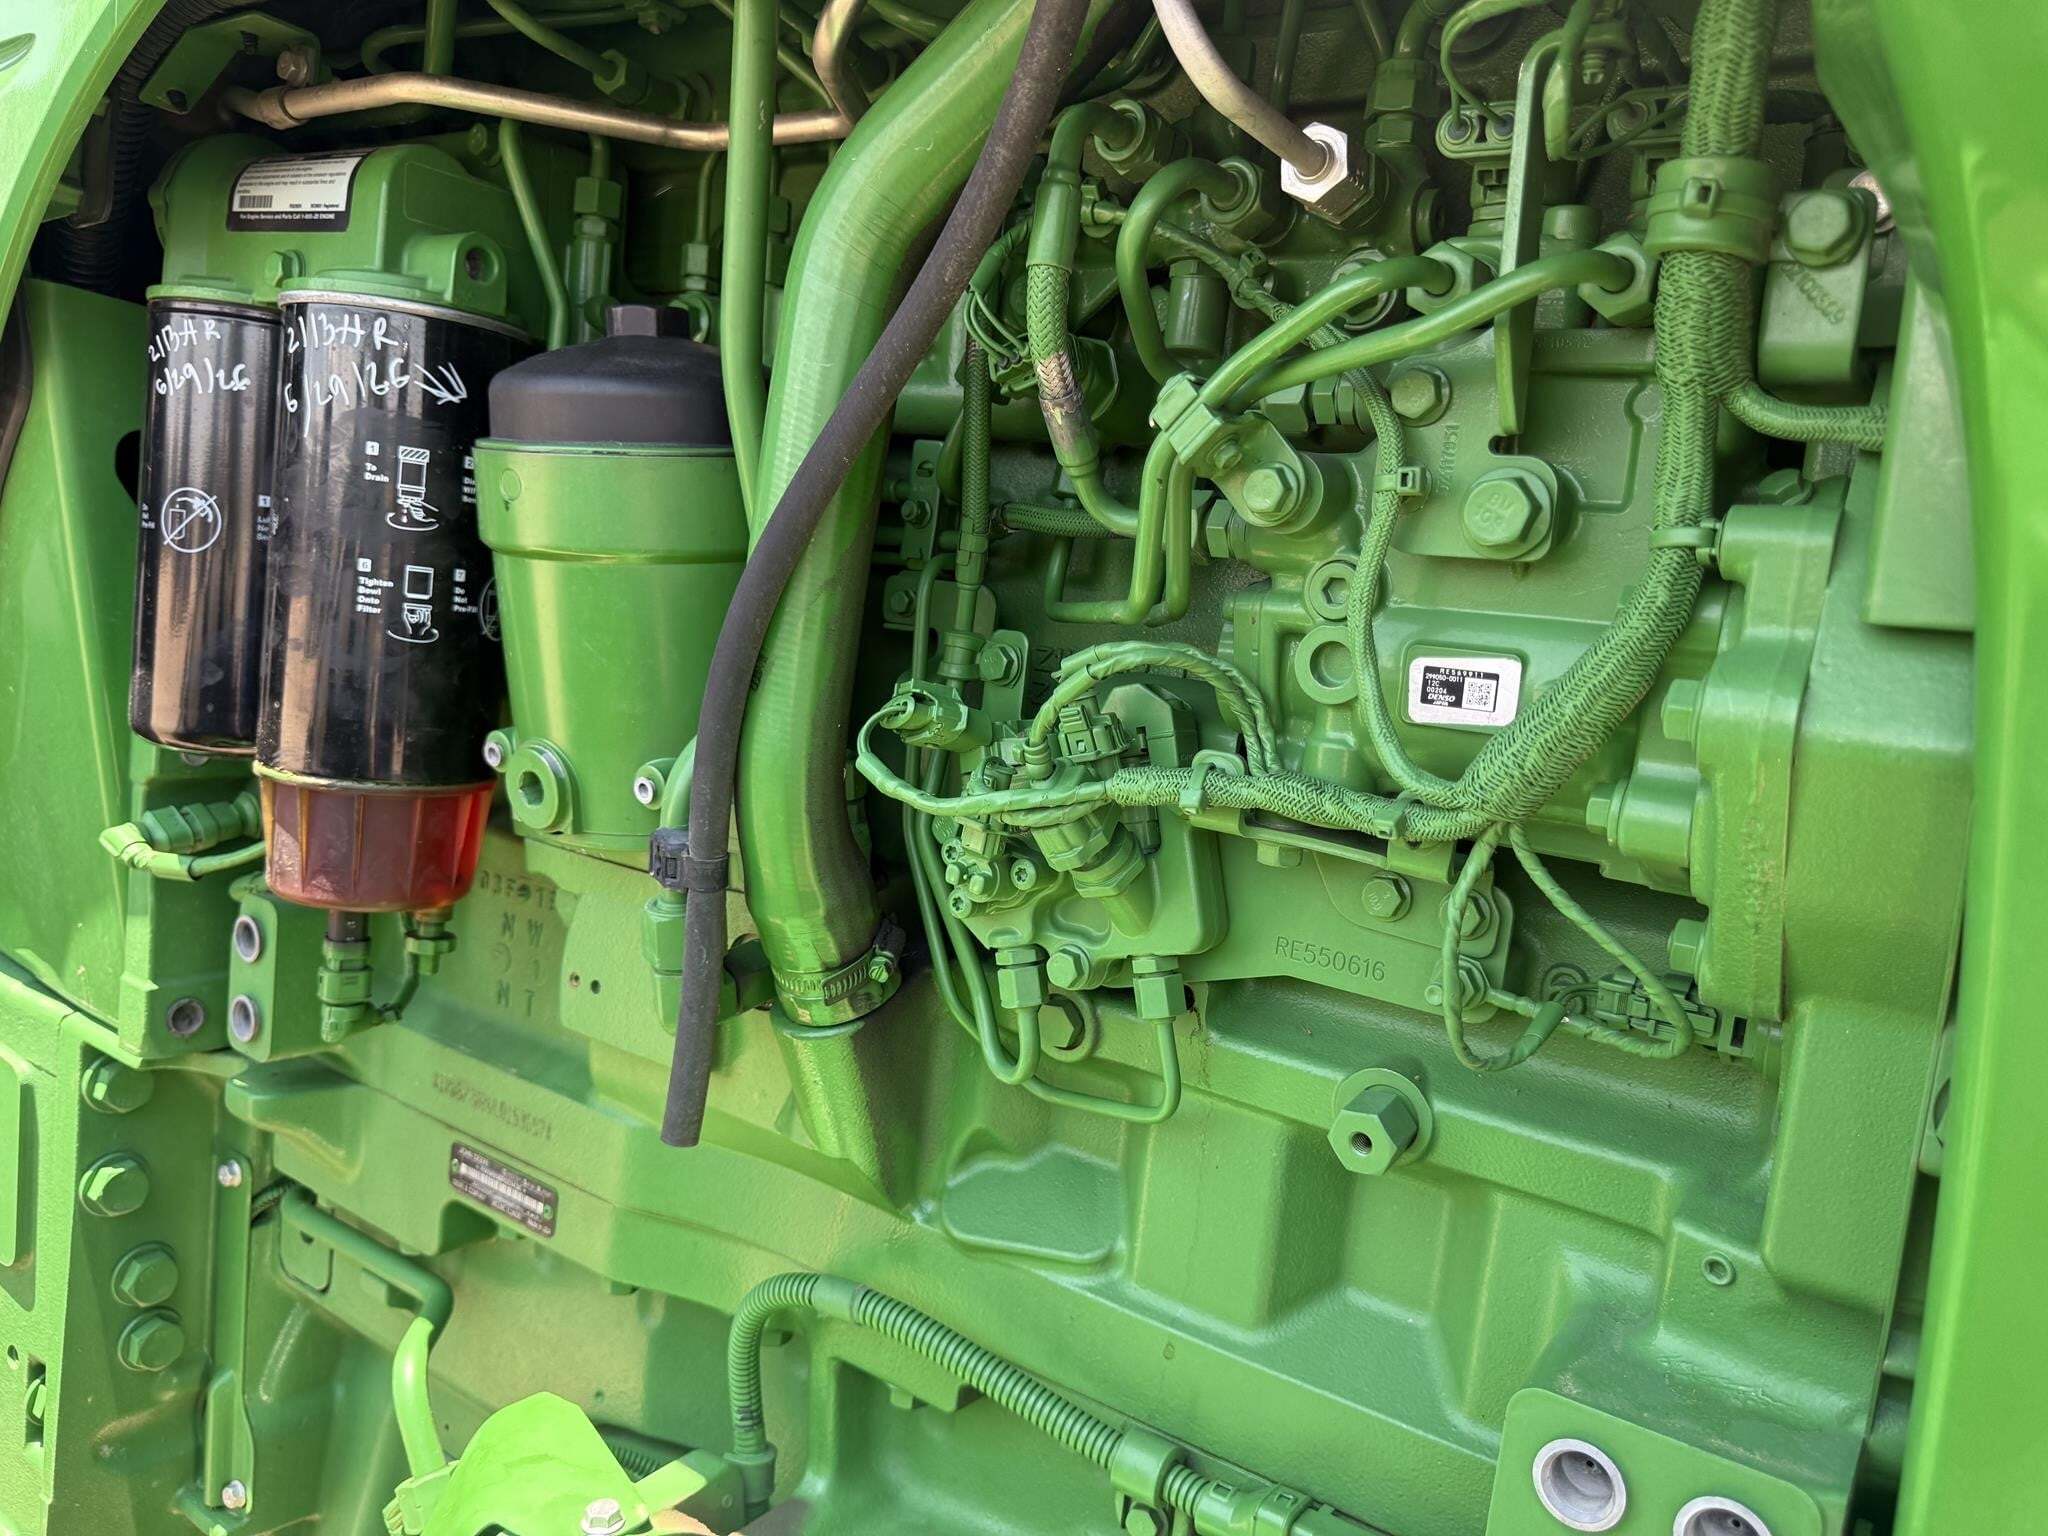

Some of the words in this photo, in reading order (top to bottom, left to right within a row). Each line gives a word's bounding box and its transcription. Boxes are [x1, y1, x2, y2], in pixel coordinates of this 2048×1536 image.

[365, 462, 377, 471] To
[364, 472, 390, 483] Drain
[358, 576, 394, 588] Tighten
[356, 595, 380, 605] Onto
[355, 604, 381, 614] Filter
[1427, 693, 1456, 702] DENSO
[1275, 935, 1386, 982] RE550616
